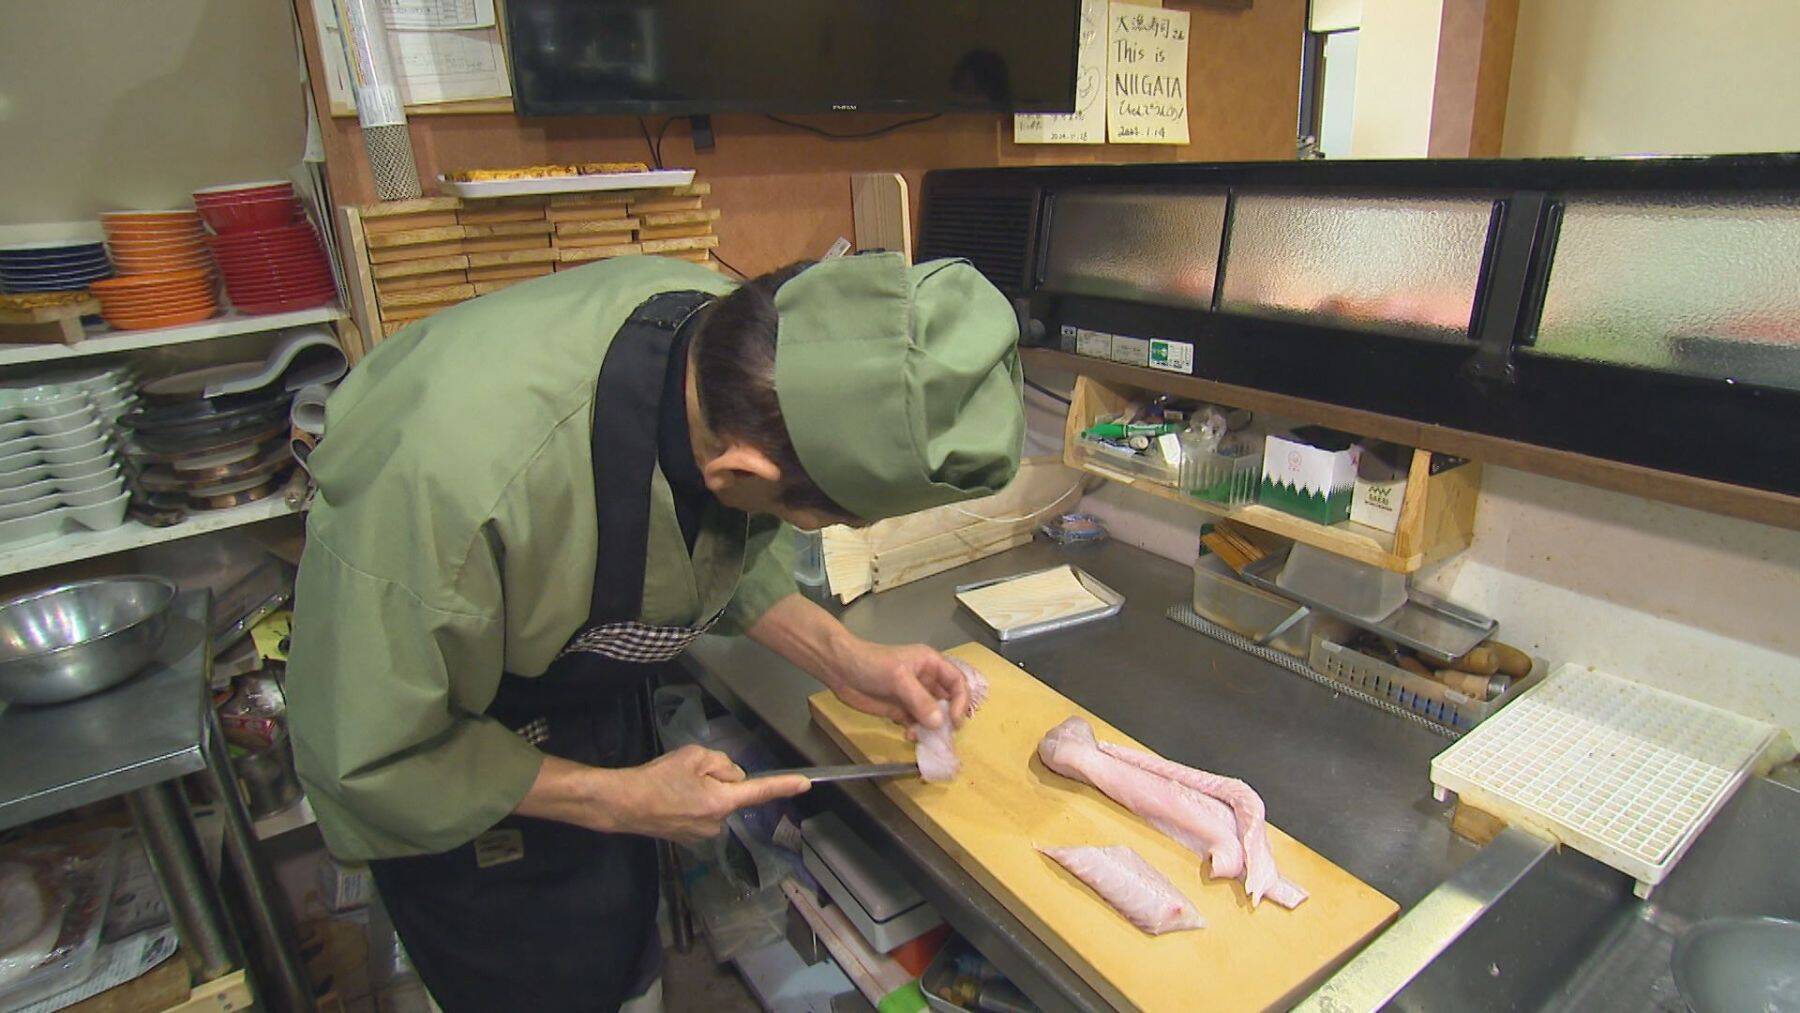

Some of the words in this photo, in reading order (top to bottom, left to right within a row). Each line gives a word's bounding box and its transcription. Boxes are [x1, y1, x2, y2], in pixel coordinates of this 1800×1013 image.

[1113, 38, 1146, 63] This
[1155, 47, 1166, 63] is
[1115, 73, 1182, 99] NIIGATA
